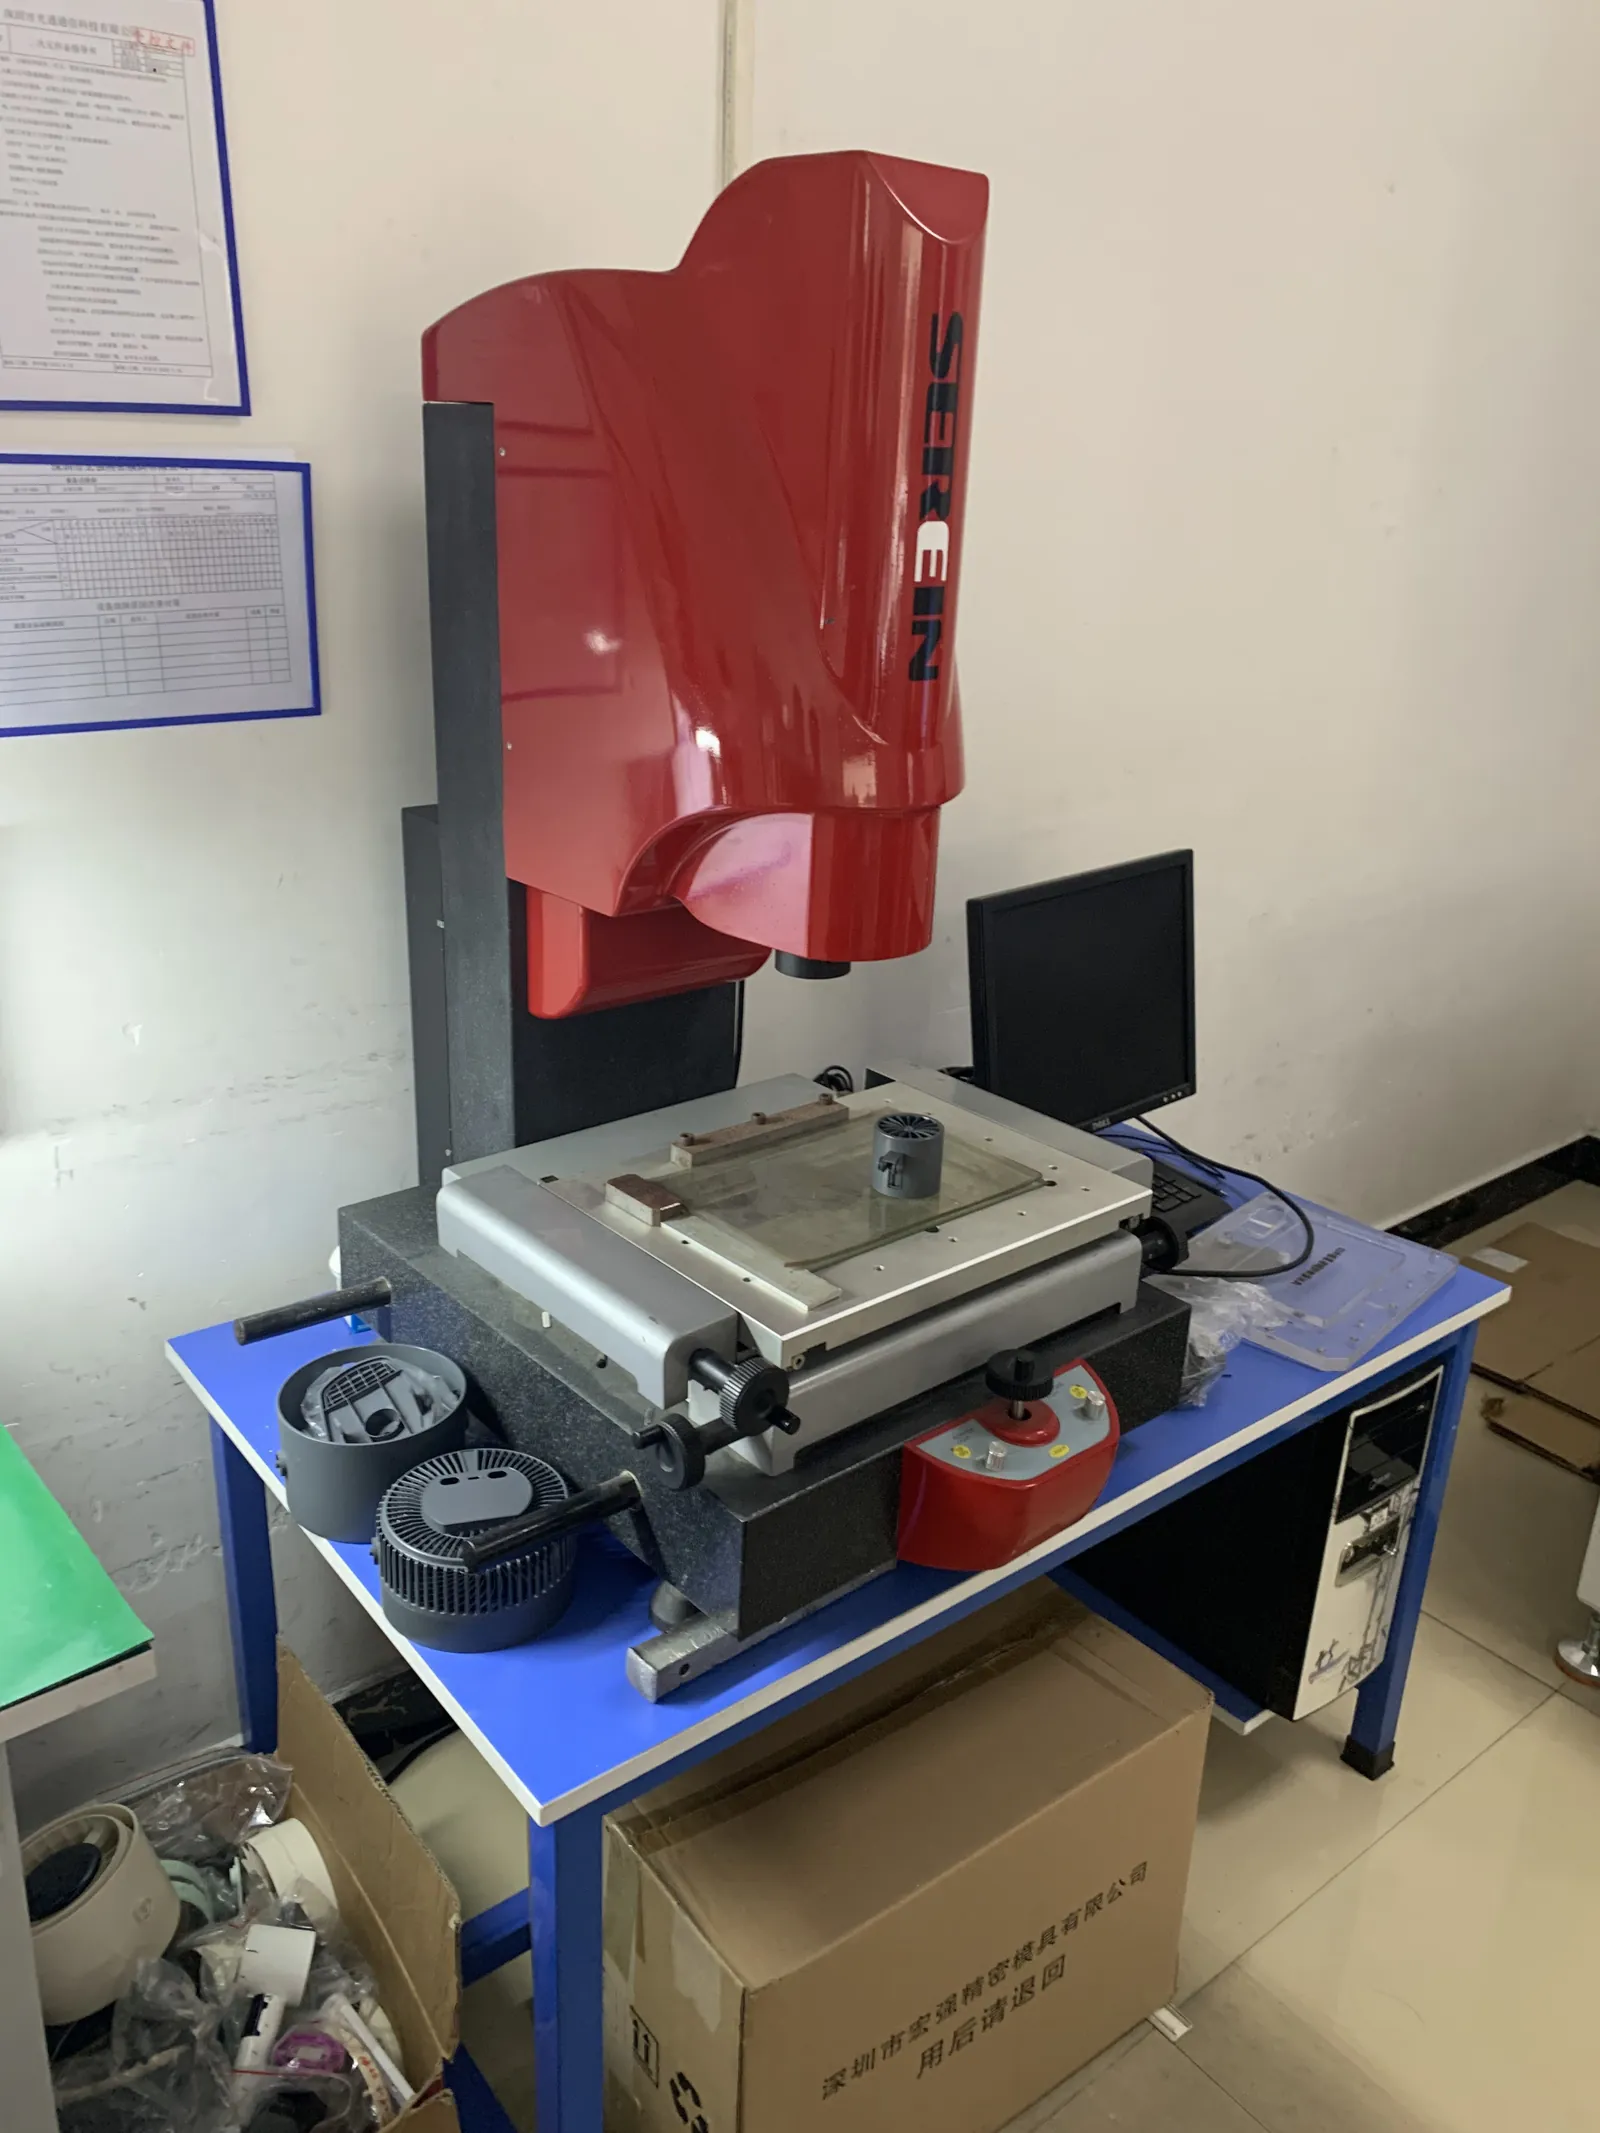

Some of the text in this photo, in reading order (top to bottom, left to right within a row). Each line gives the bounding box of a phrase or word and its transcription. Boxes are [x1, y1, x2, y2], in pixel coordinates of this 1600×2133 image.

[908, 312, 963, 682] SEREIN
[916, 1954, 1066, 2079] 用后请退回
